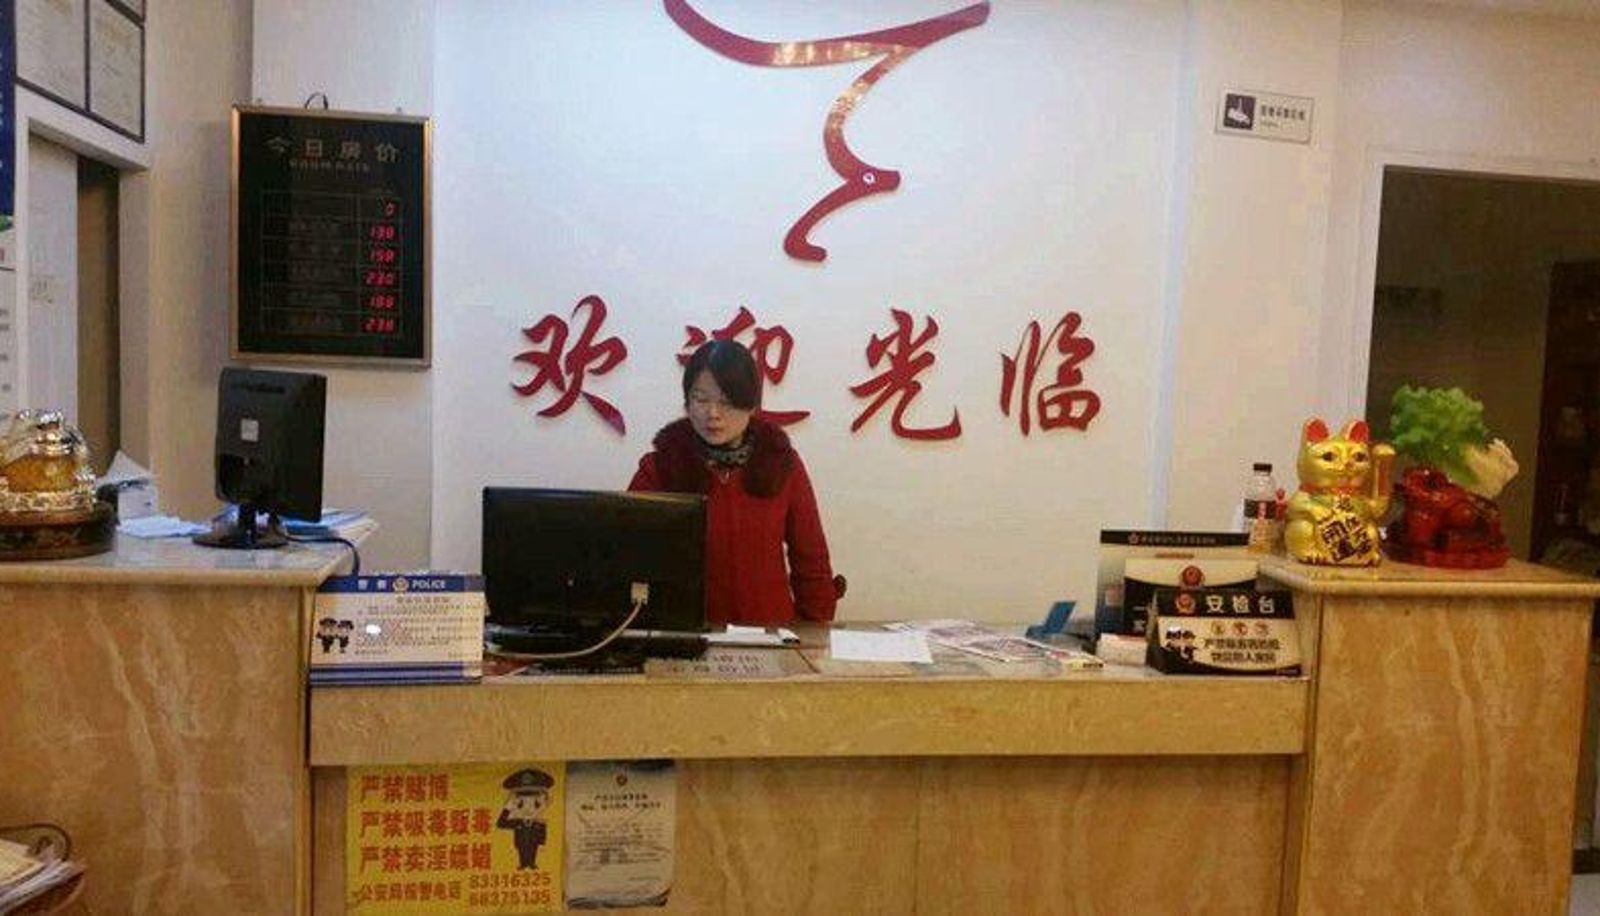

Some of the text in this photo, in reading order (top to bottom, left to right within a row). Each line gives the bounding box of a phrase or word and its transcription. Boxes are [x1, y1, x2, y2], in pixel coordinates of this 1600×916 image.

[264, 136, 399, 163] 今日房价
[511, 293, 1102, 441] 欢迎光临
[412, 579, 447, 590] POLICE
[360, 773, 449, 803] 严禁赌博
[359, 808, 493, 838] 严禁吸毒贩毒
[359, 842, 493, 875] 严禁卖淫嫖娼
